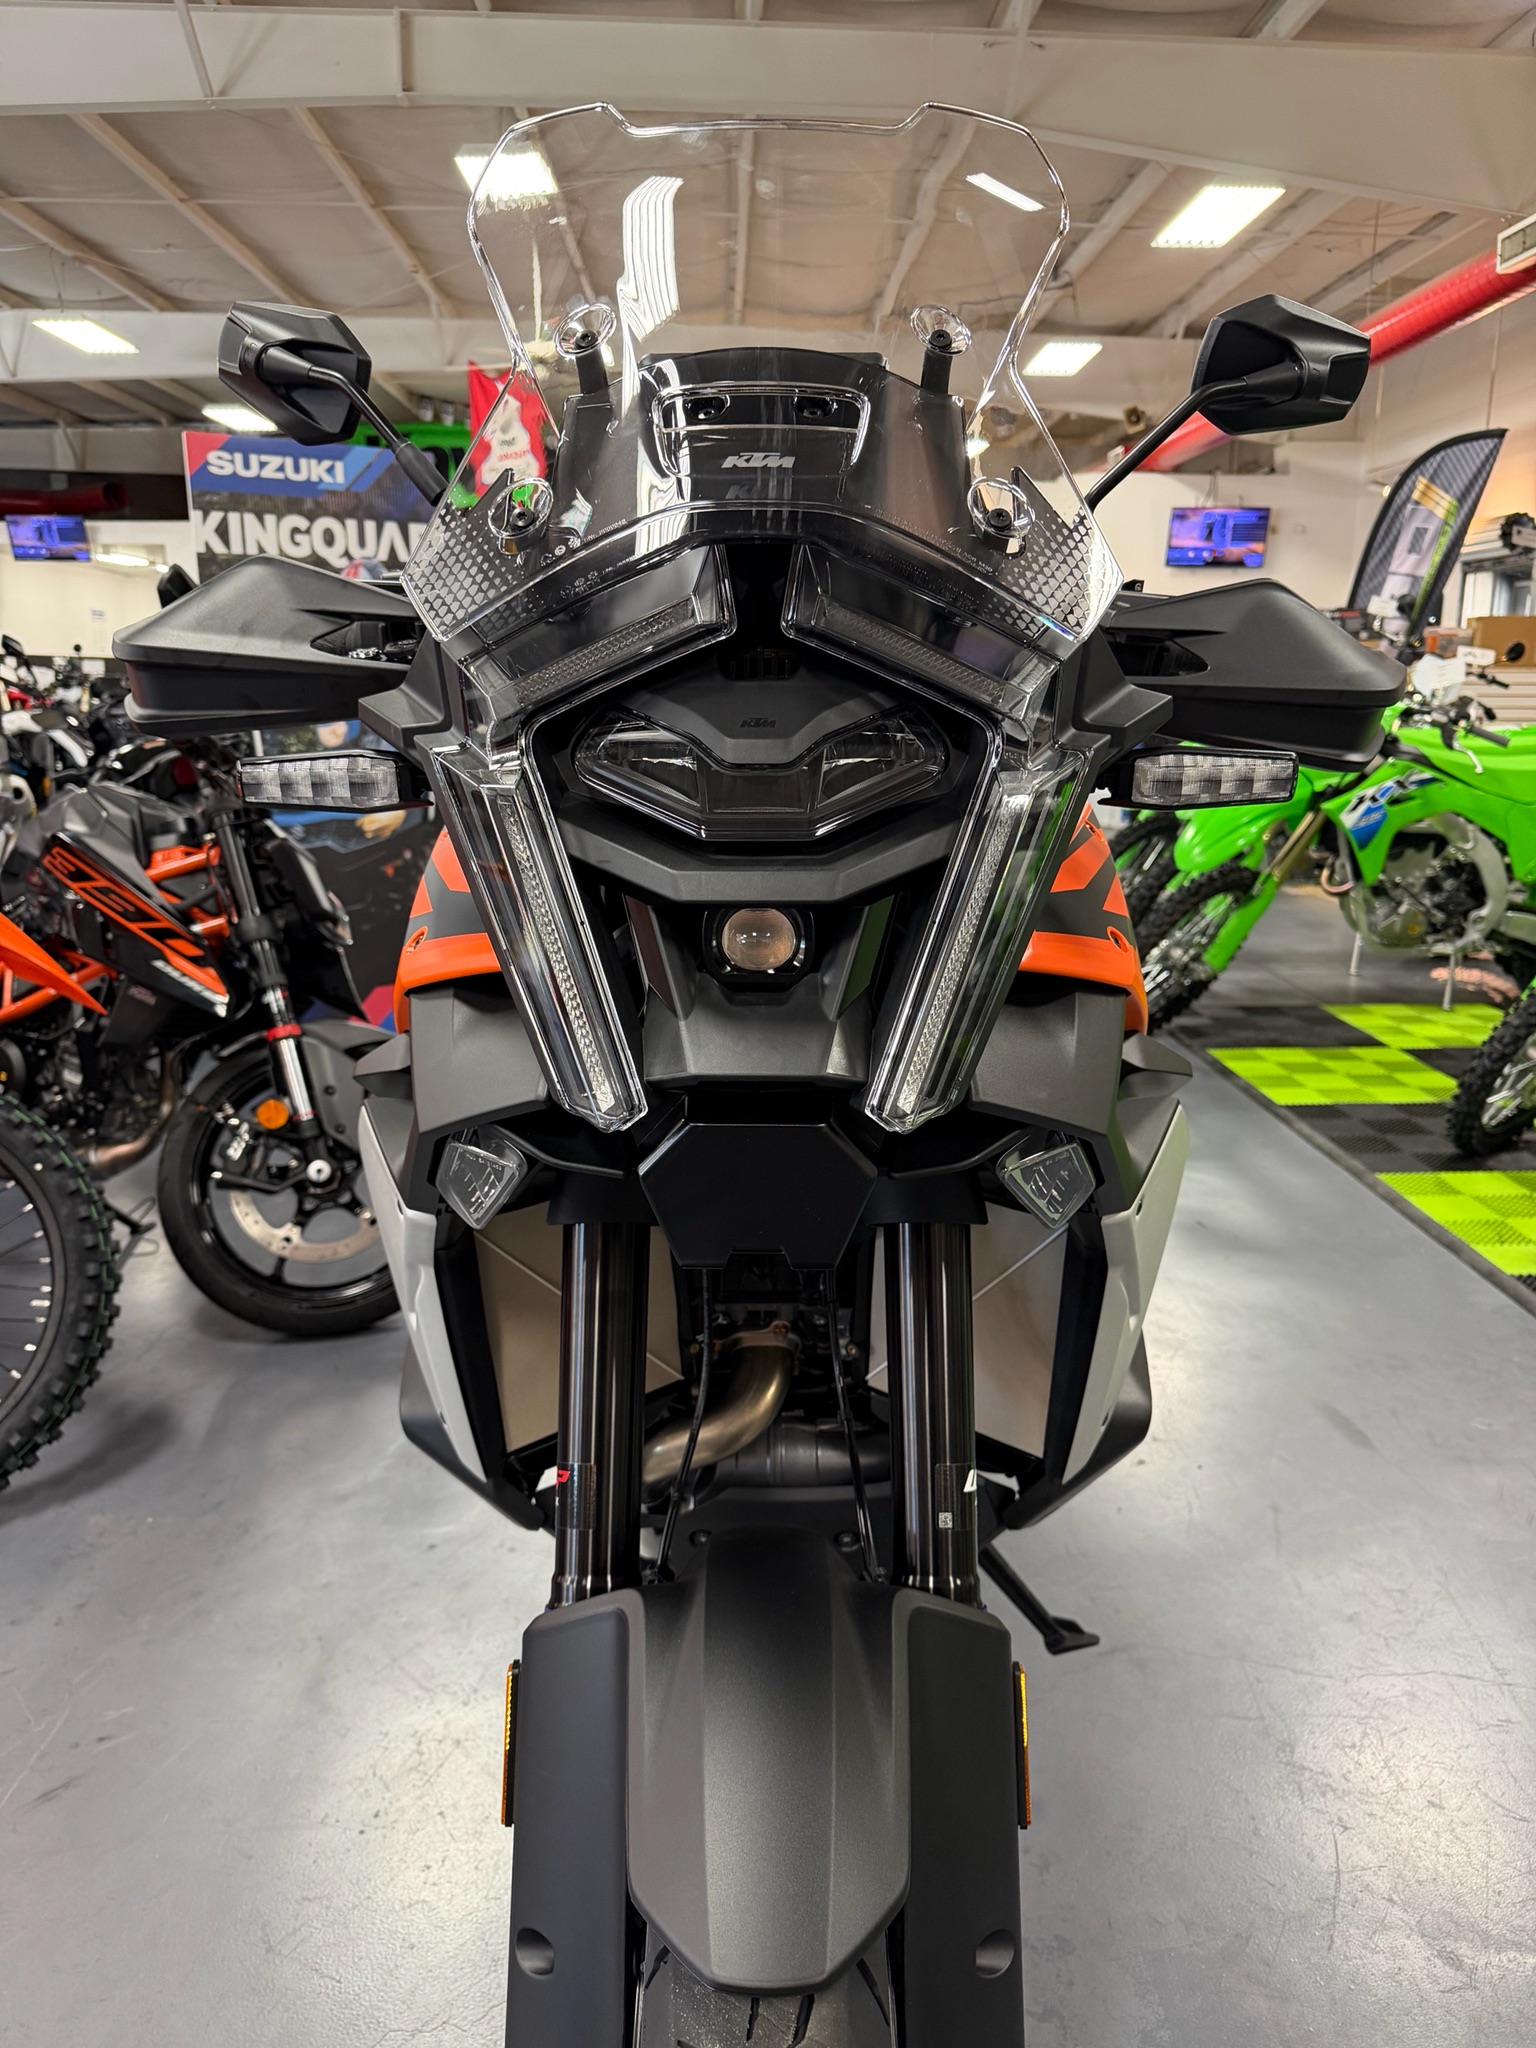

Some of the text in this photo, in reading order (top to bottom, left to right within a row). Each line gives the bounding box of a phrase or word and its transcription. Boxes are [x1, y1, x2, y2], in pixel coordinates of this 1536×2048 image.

[206, 450, 345, 484] SUZUKI
[721, 452, 796, 469] KTM
[740, 717, 777, 729] KTM
